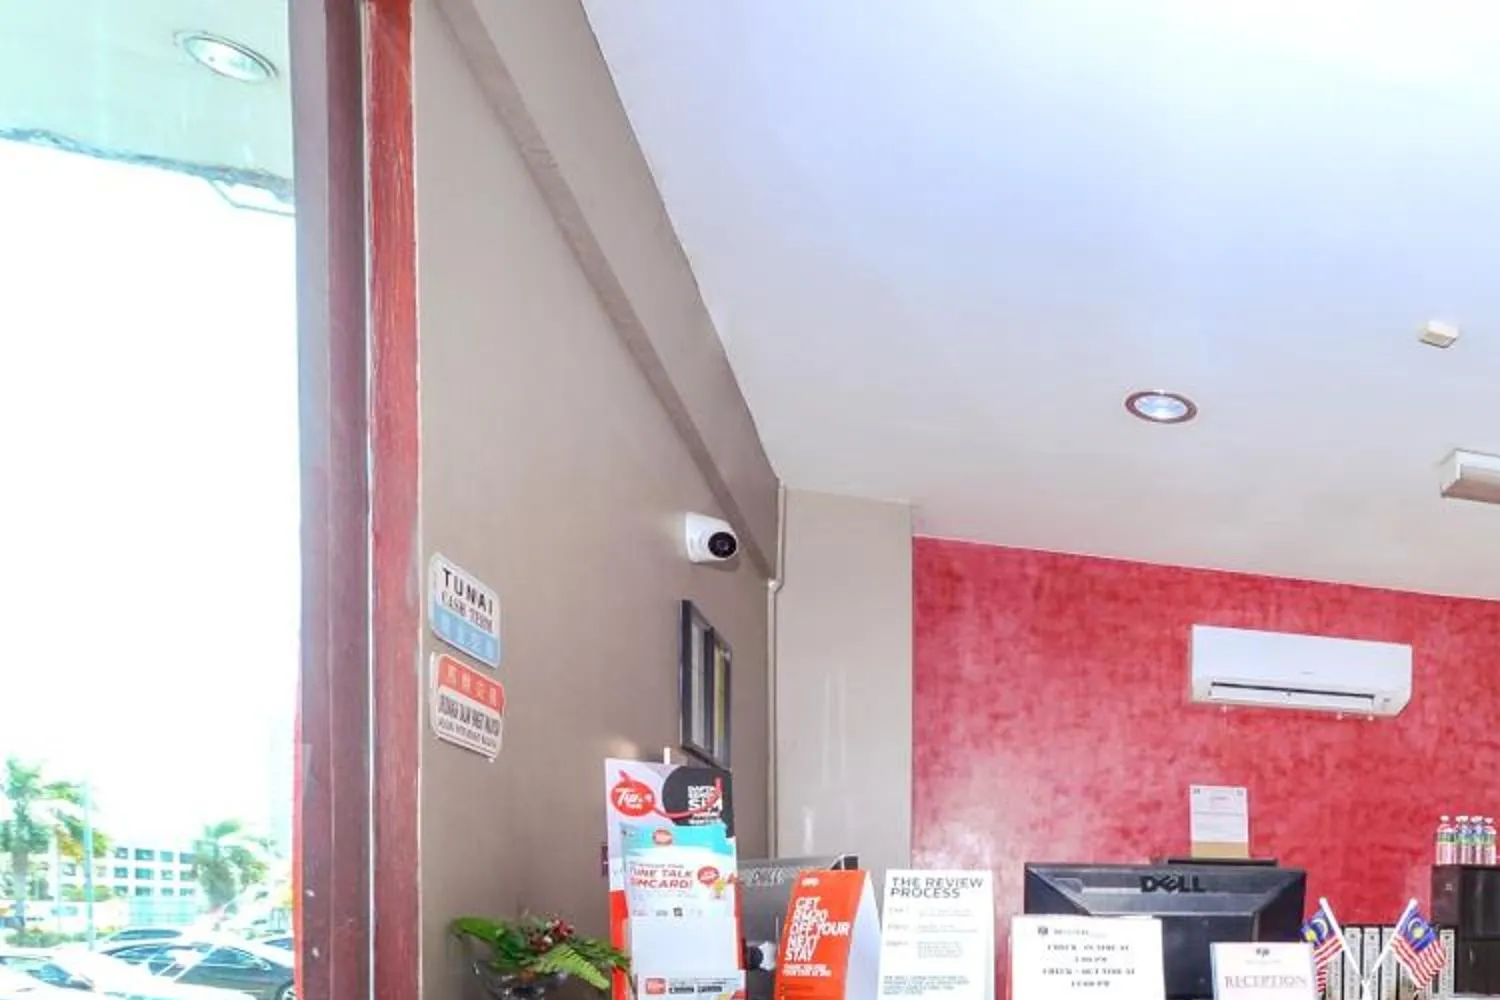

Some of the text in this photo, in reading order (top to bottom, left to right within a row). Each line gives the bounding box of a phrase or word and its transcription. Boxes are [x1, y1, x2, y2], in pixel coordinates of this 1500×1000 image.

[442, 567, 493, 617] TUNAI
[892, 876, 984, 889] THE REVIEW
[1140, 875, 1206, 893] DELL
[890, 887, 961, 899] PROCESS
[784, 947, 815, 962] STAY
[1223, 975, 1308, 989] RECEPTION
